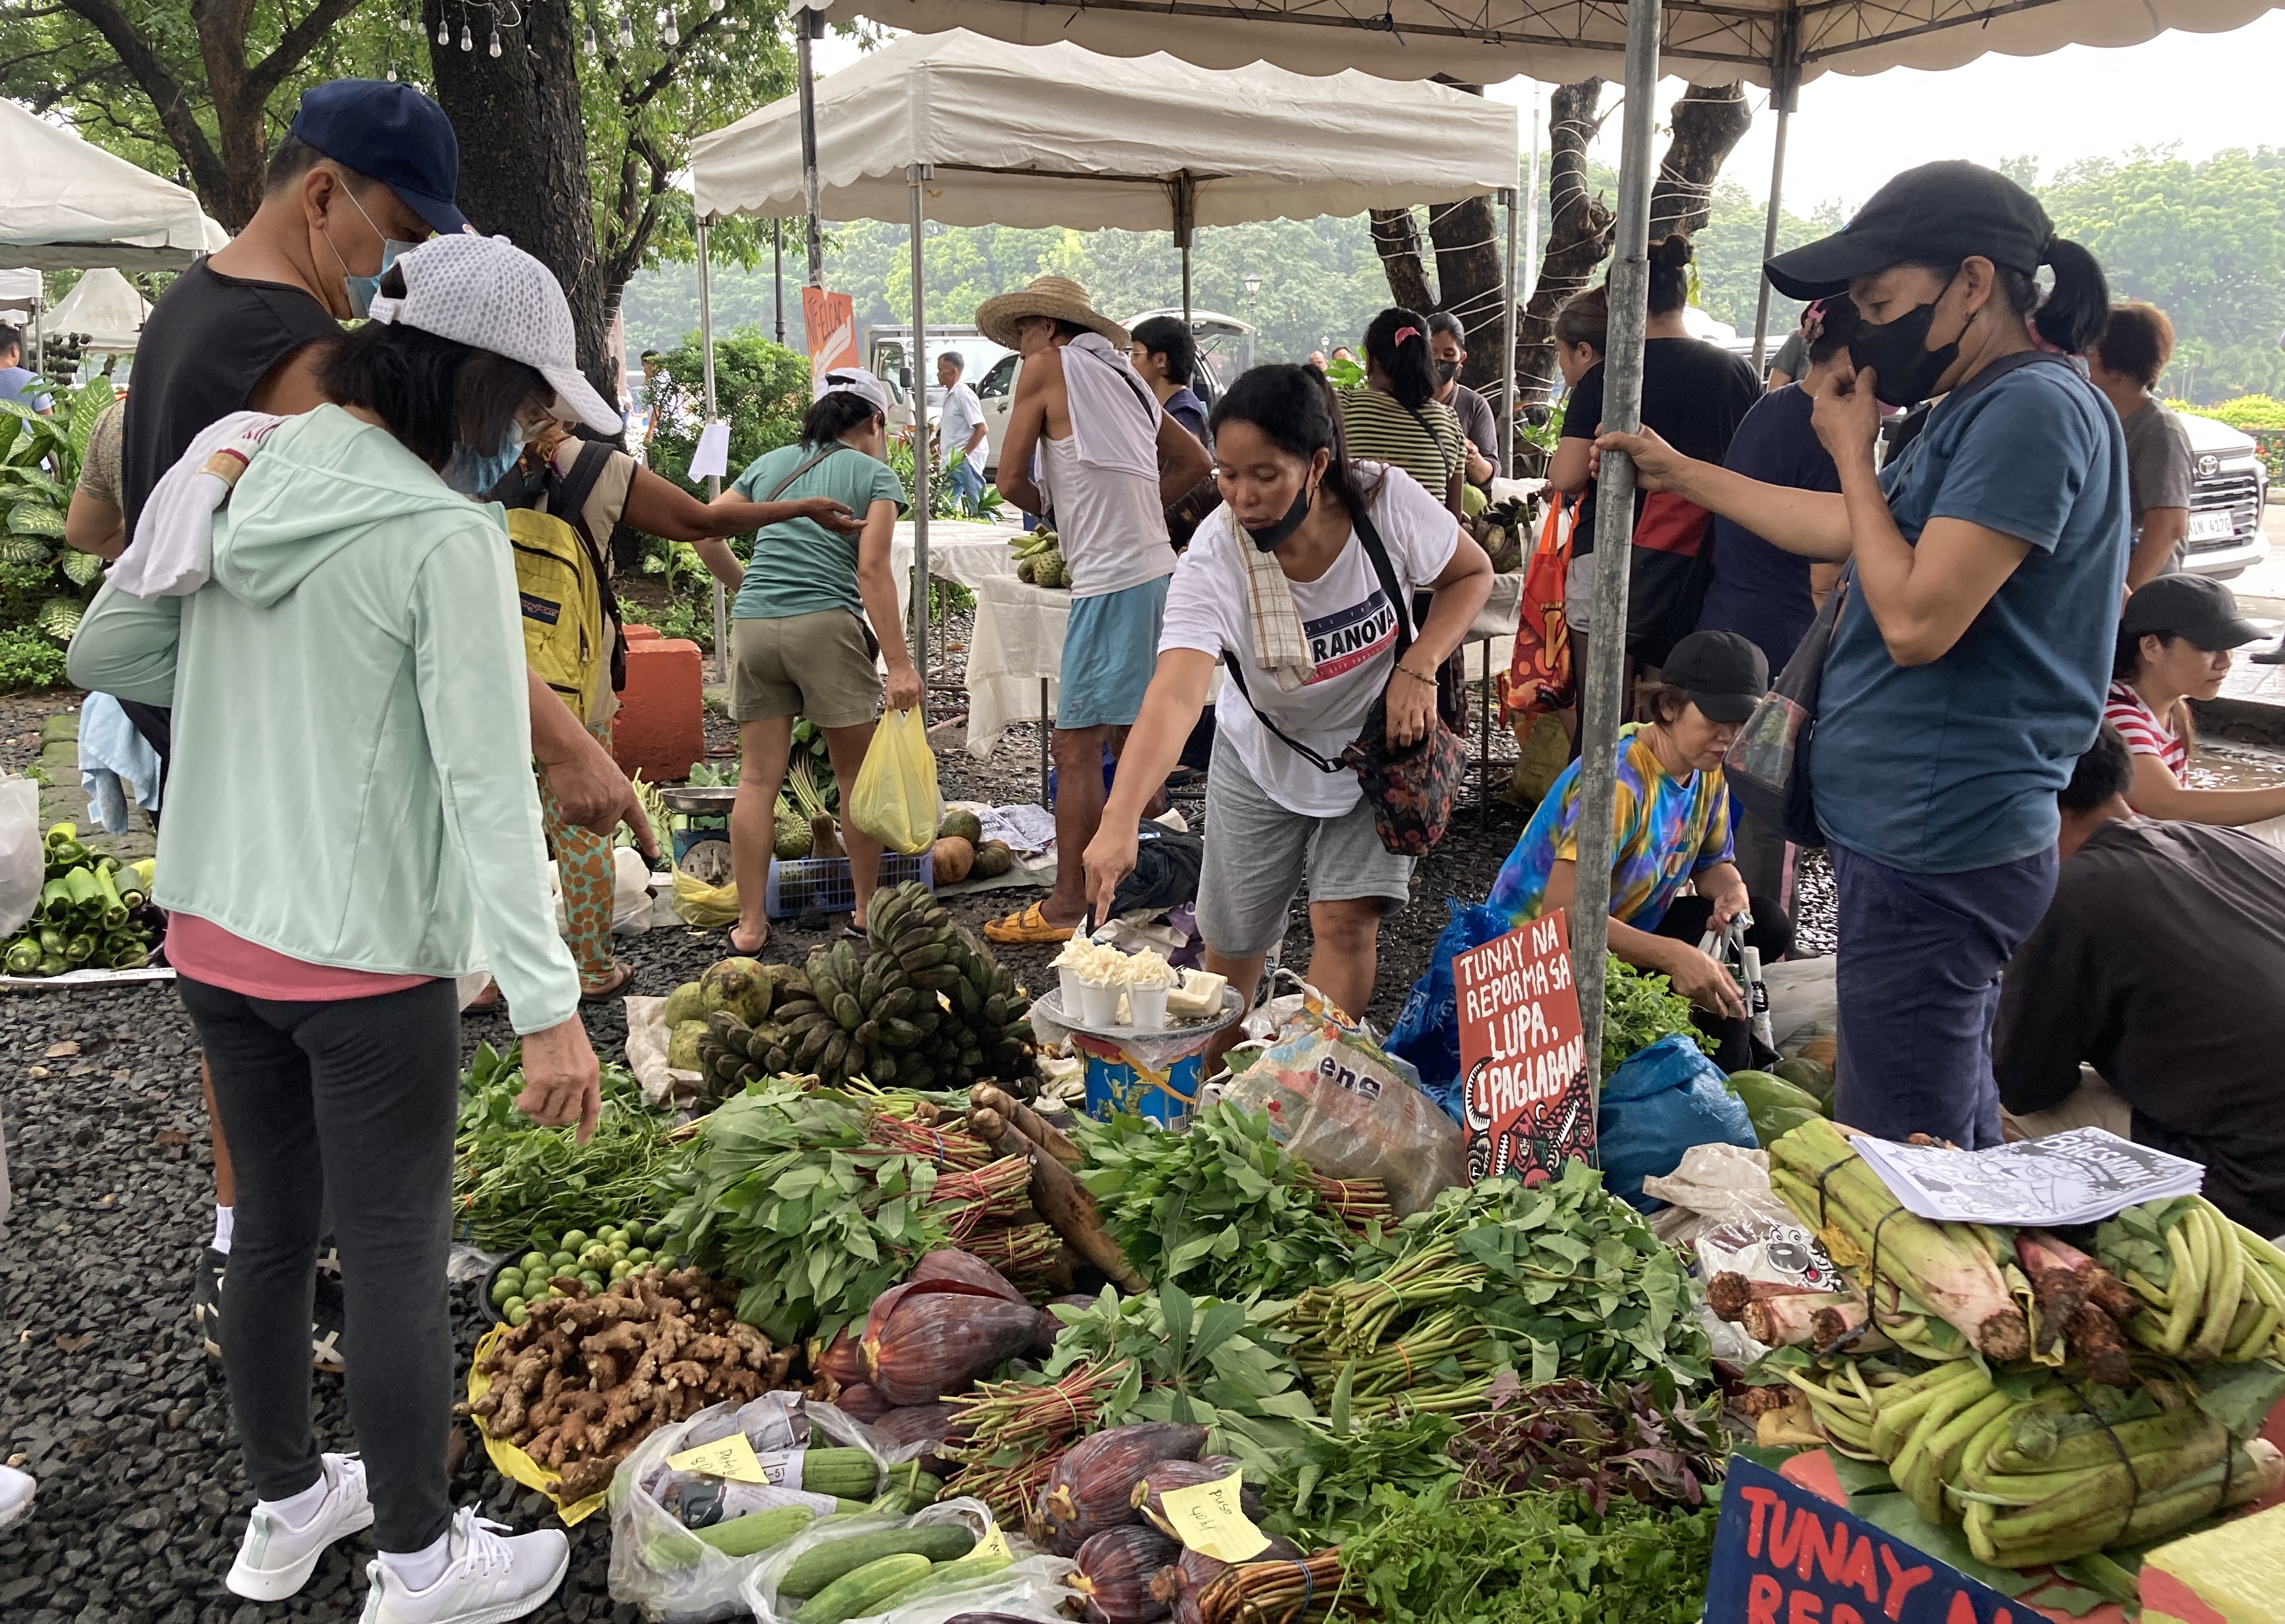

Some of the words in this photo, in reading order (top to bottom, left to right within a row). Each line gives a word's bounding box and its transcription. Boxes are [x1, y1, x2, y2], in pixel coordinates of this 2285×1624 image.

[1310, 605, 1396, 663] RANOVA
[1460, 932, 1523, 985] TUNAY
[1533, 917, 1559, 958] NA
[1467, 959, 1549, 1023] REPORMA
[1550, 953, 1571, 991] SA
[1489, 1001, 1559, 1061] LUPA,
[1477, 1033, 1585, 1122] IPAGLABAN!
[1740, 1486, 1933, 1622] TUNAY
